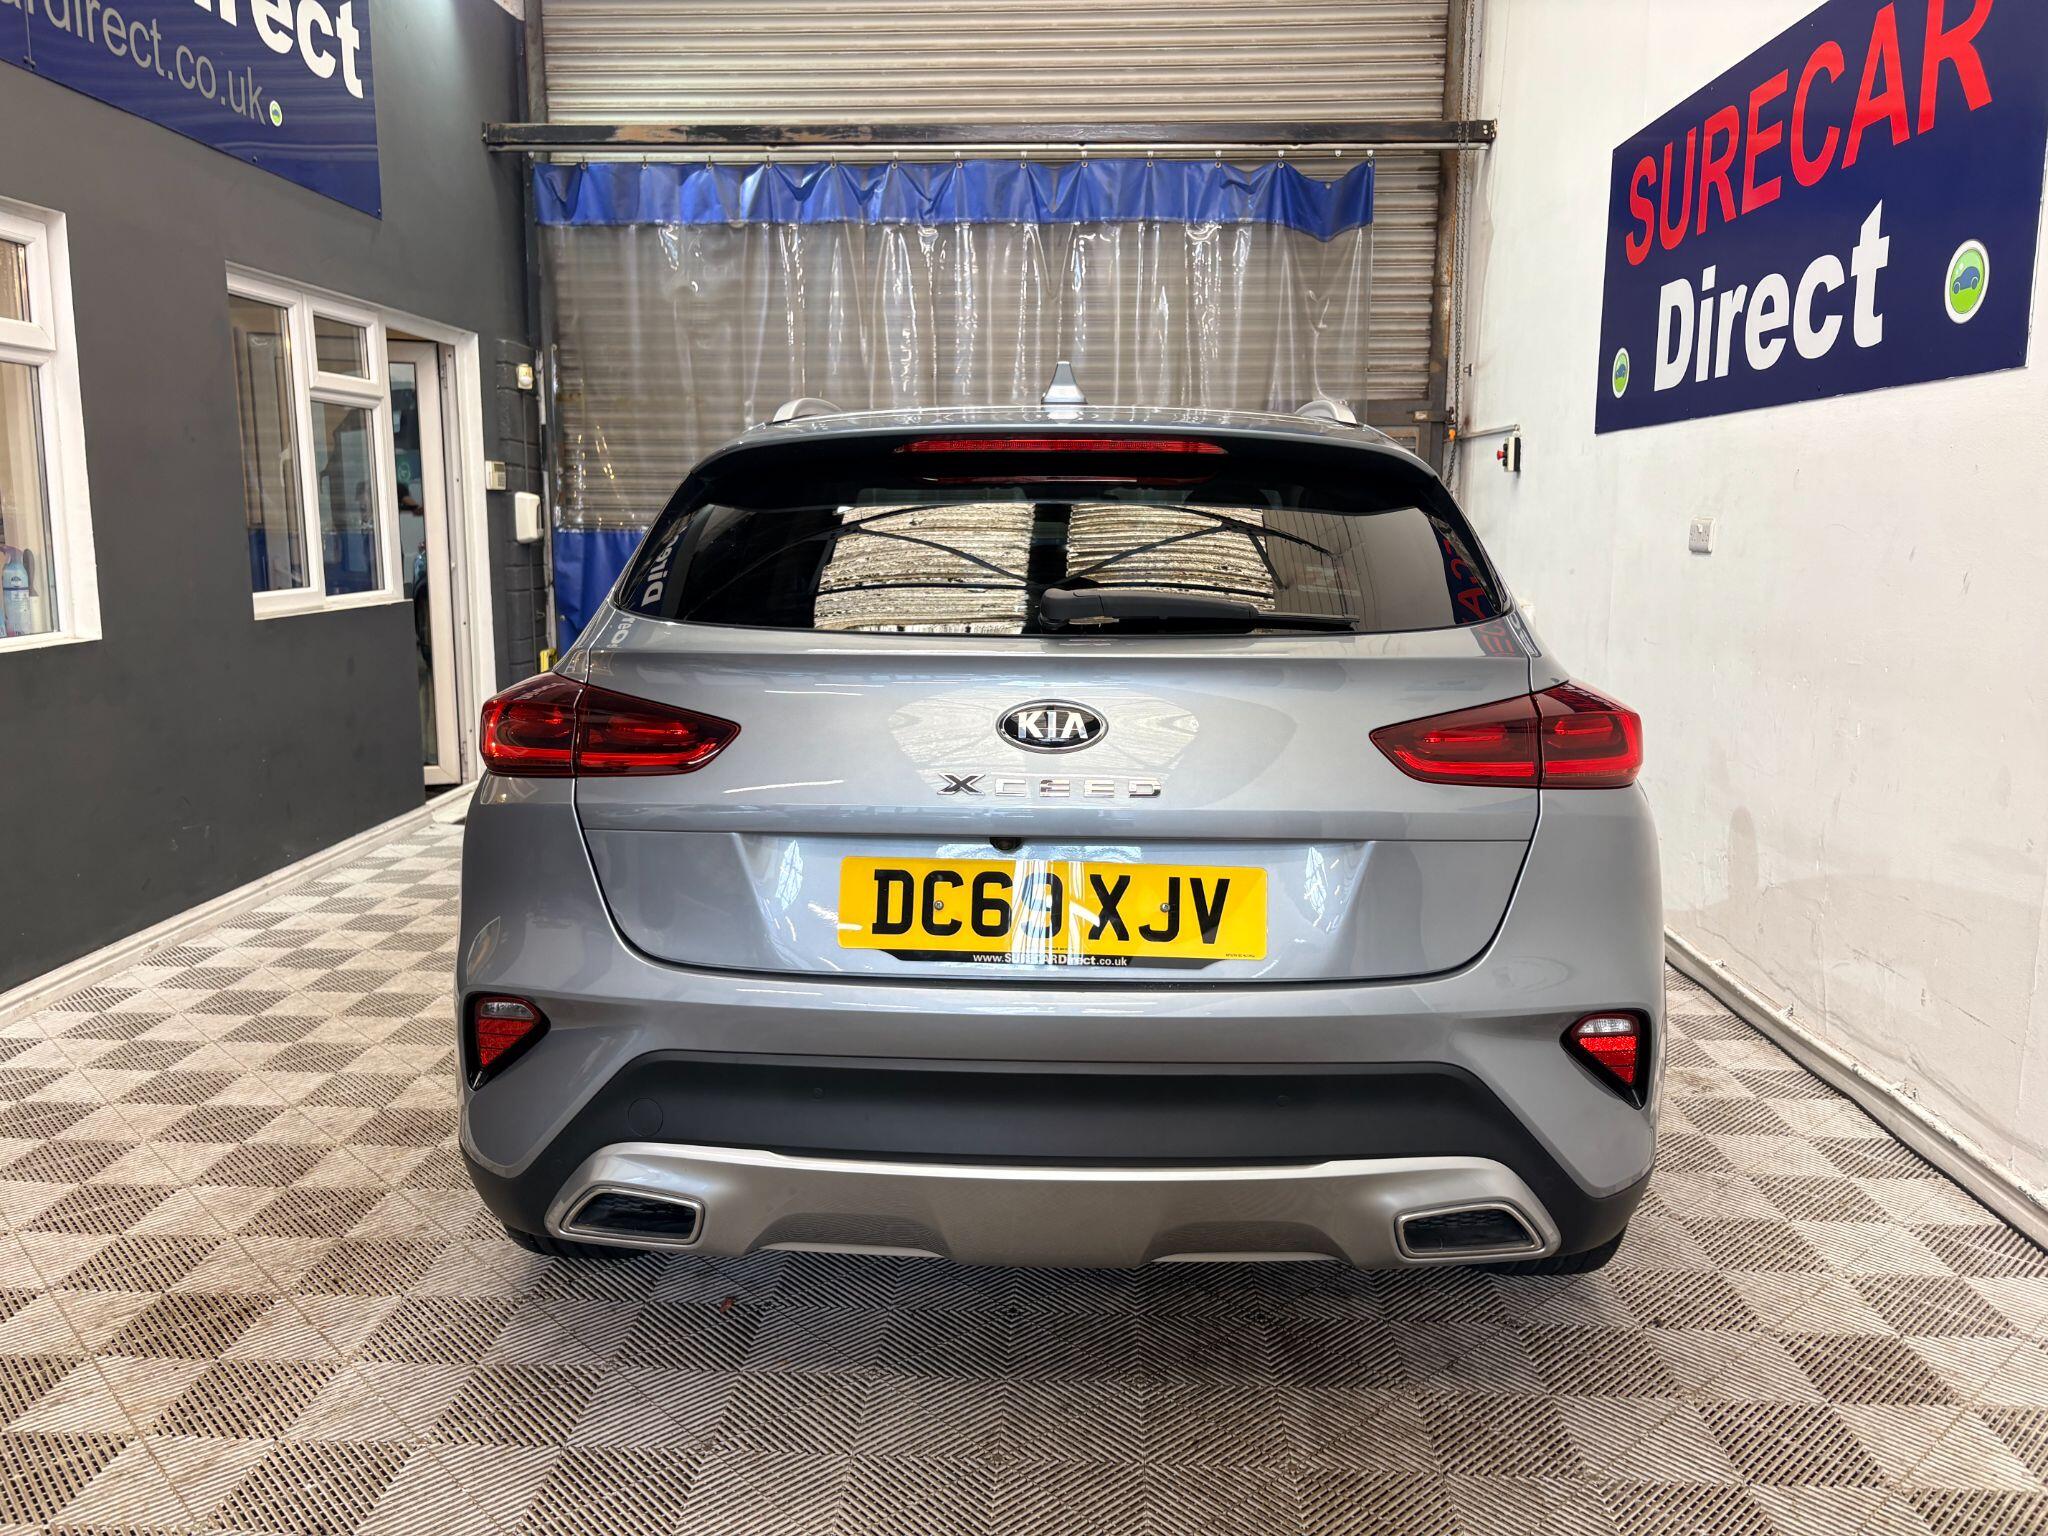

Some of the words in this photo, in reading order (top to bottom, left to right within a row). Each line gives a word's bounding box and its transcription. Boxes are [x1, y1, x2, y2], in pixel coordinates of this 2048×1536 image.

[1625, 0, 1993, 266] SURECAR
[1653, 198, 1890, 393] Direct
[1017, 710, 1089, 739] KIA
[936, 772, 1162, 798] XCEED
[871, 868, 1064, 938] DC69
[1087, 873, 1231, 945] XJV
[972, 952, 1128, 967] www.SUARDirect.co.uk
